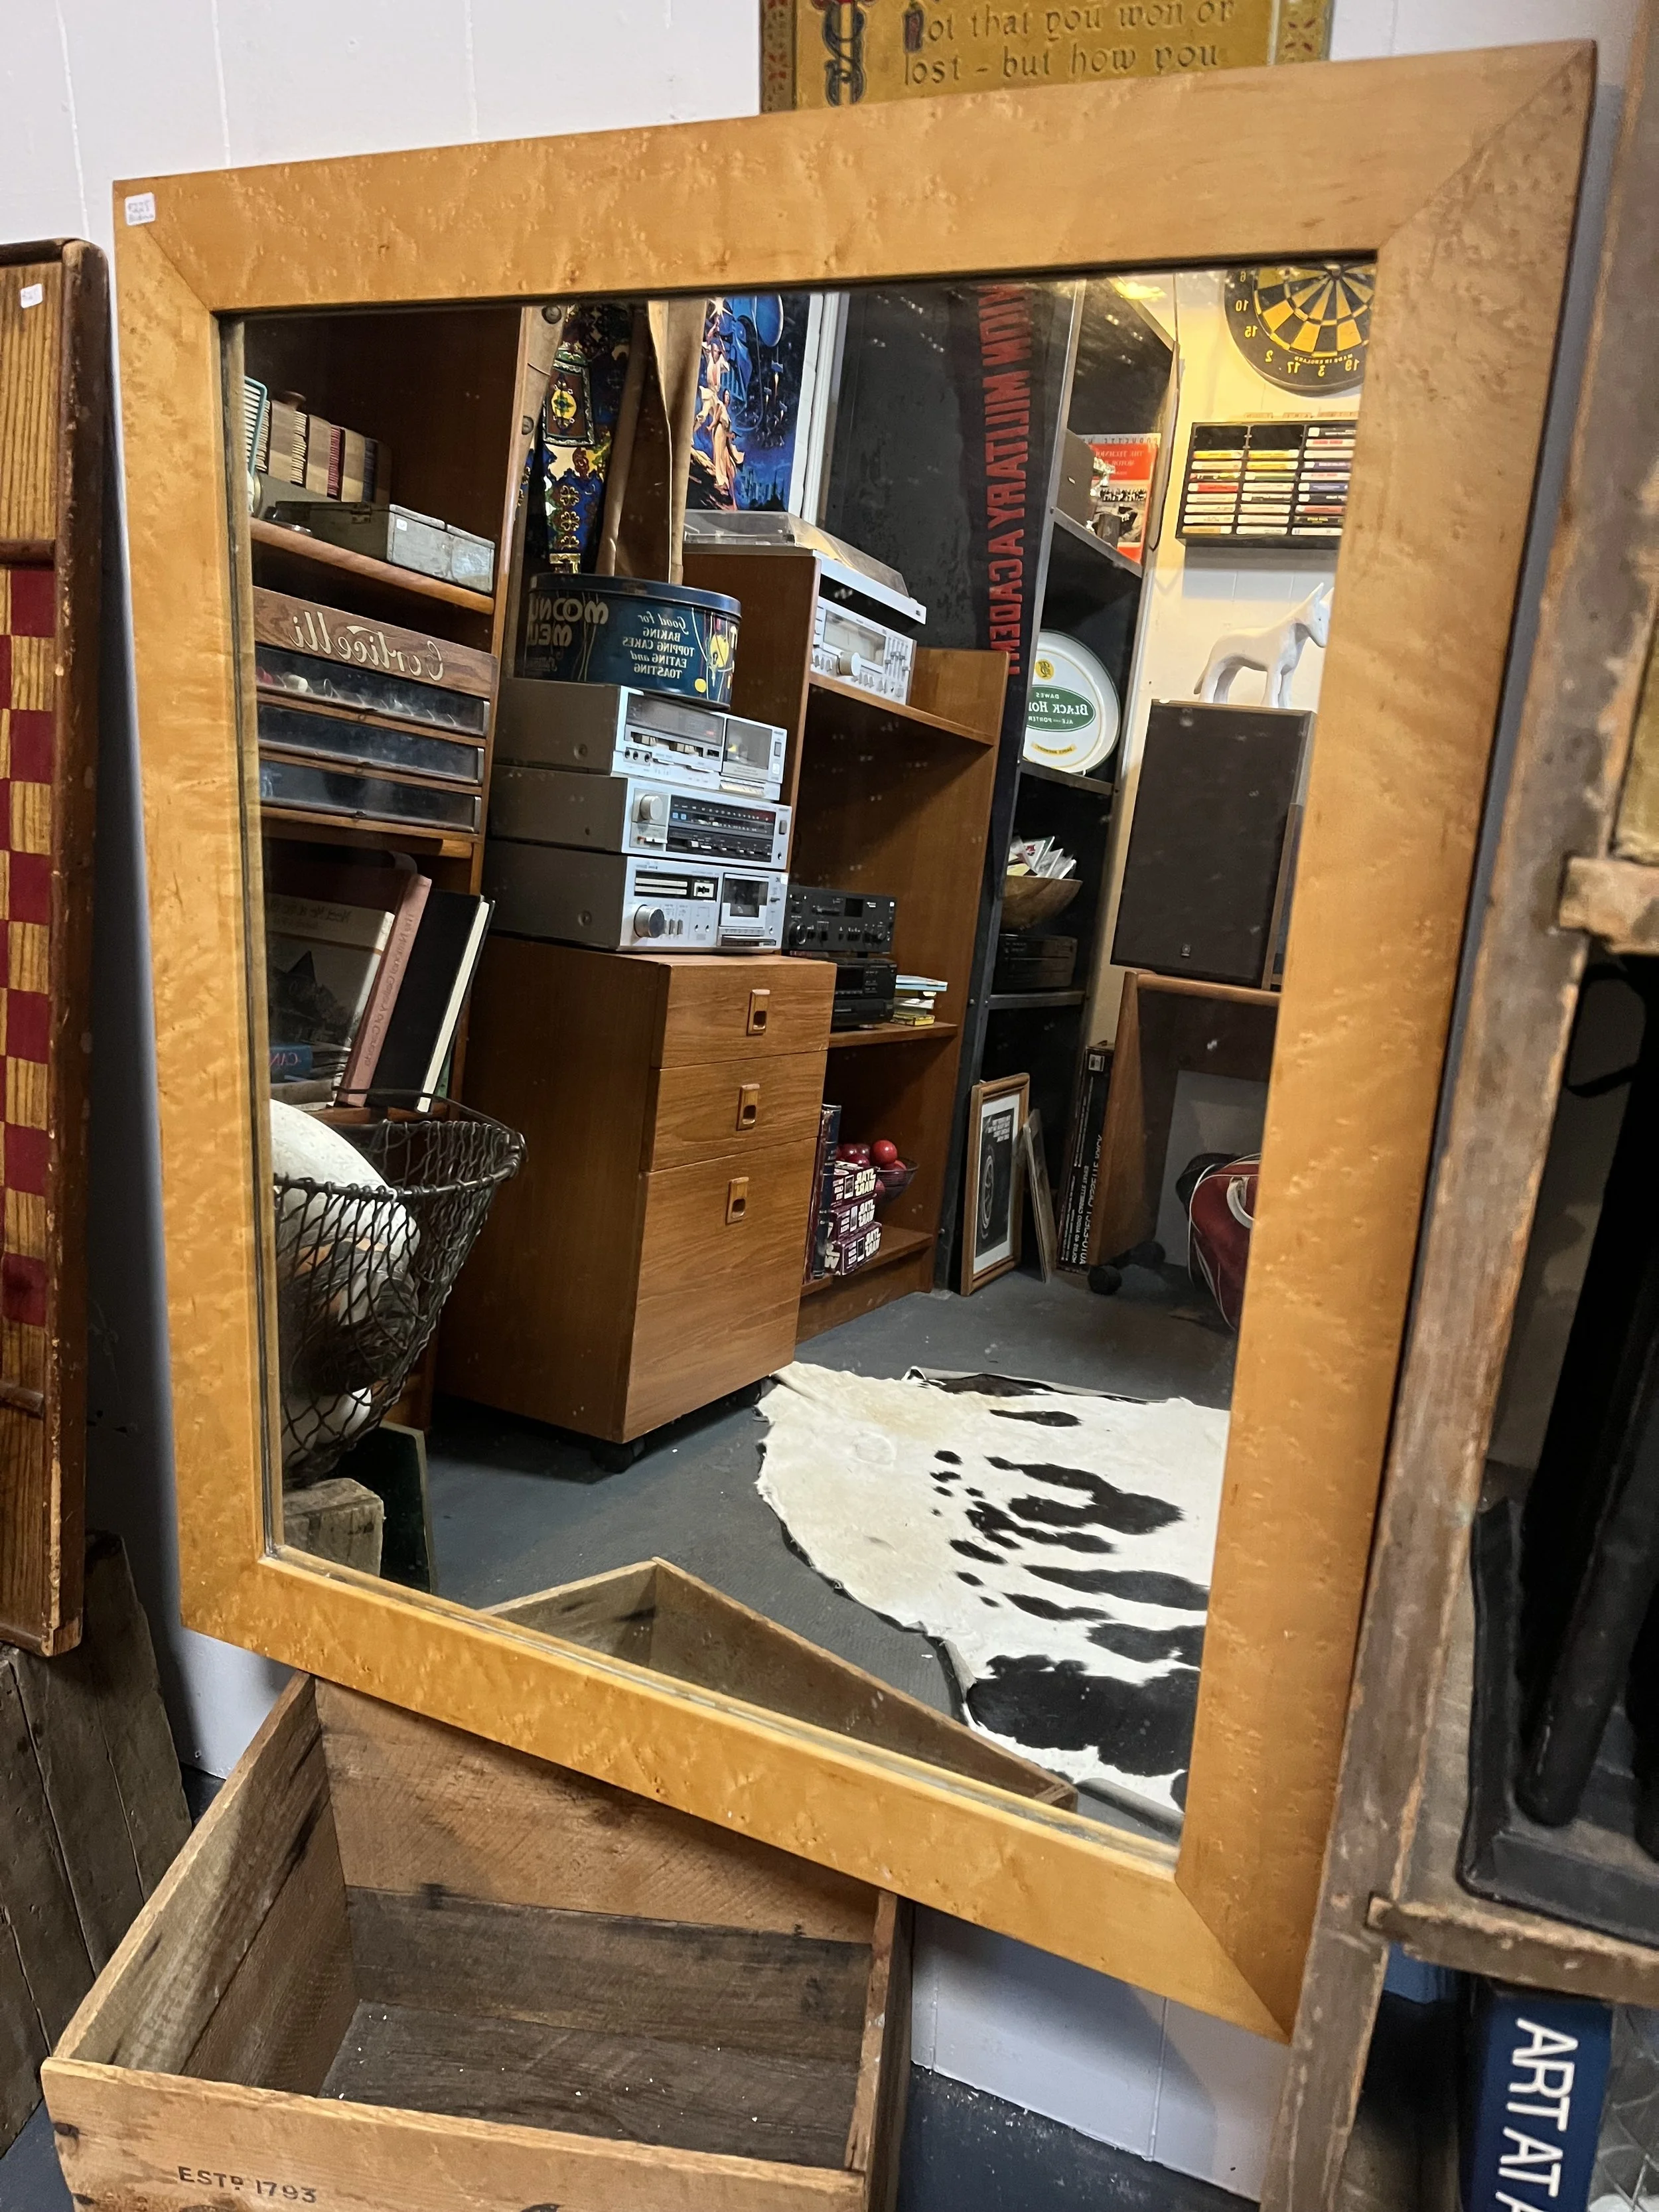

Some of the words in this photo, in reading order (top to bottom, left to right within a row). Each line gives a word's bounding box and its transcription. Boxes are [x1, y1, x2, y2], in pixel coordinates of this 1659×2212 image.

[970, 5, 1029, 38] that
[1045, 7, 1100, 41] you
[1118, 1, 1182, 27] won
[1197, 0, 1235, 23] or
[904, 52, 960, 86] lost
[1003, 44, 1050, 78] but
[1070, 42, 1137, 75] how
[1154, 43, 1218, 76] you
[1506, 2018, 1578, 2132] ART
[1498, 2126, 1563, 2197] AT
[255, 2179, 317, 2203] 1793
